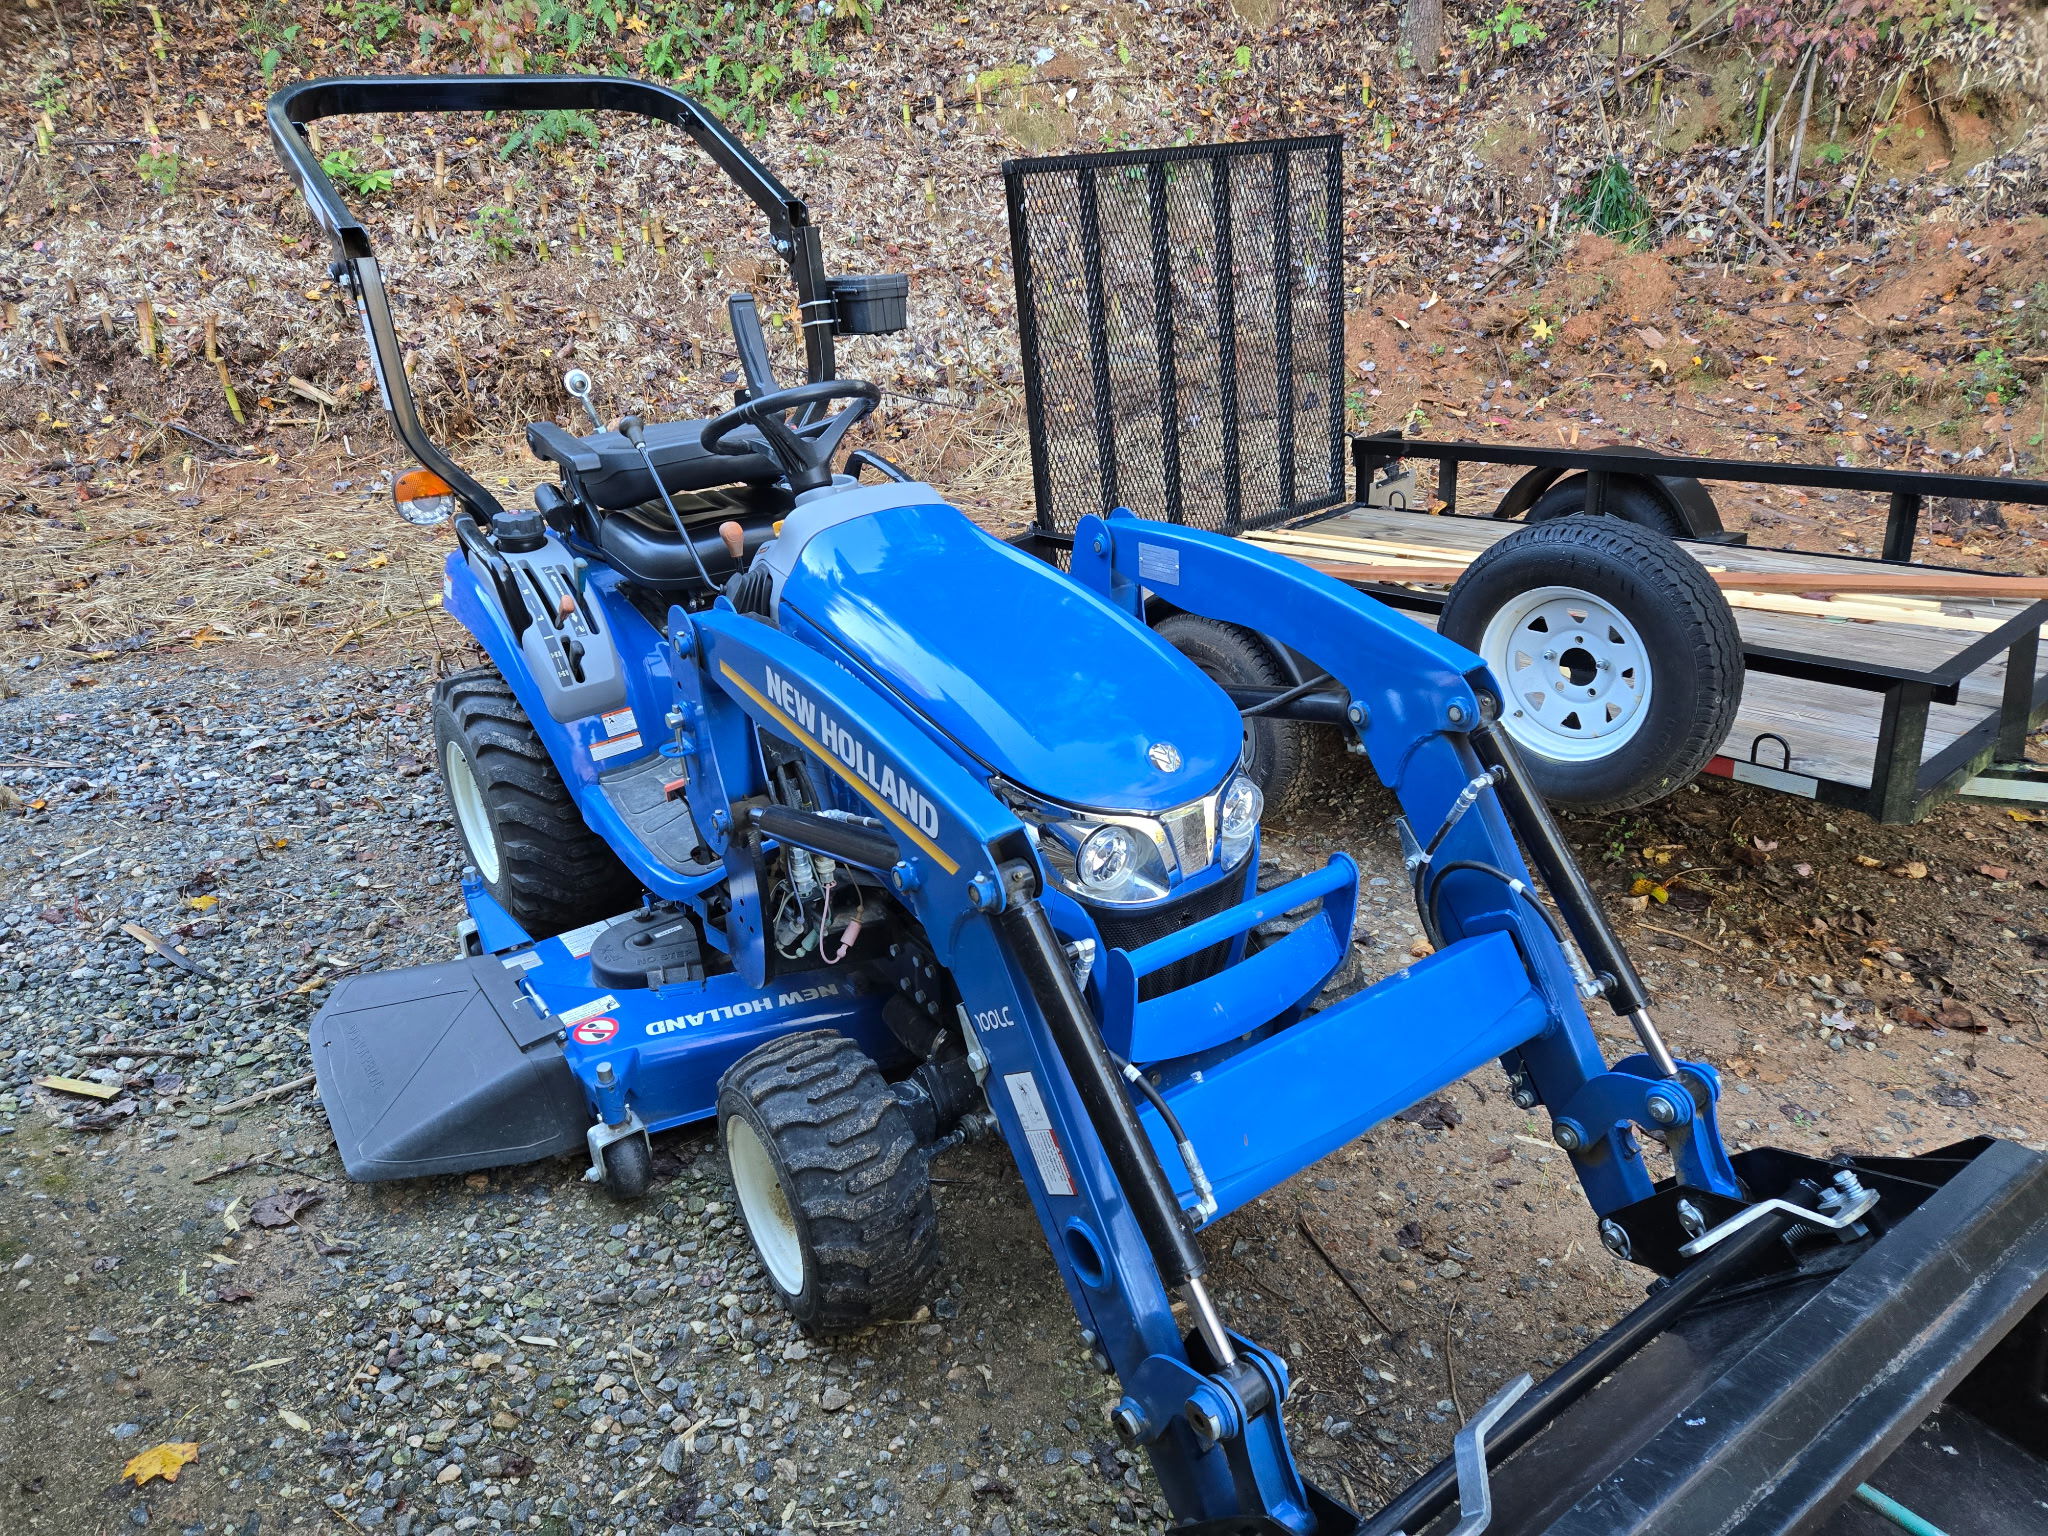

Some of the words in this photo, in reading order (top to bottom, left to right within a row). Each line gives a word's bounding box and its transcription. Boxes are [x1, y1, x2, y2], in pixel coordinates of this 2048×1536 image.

[765, 665, 816, 734] NEW
[820, 711, 939, 839] HOLLAND
[777, 983, 840, 1008] NEW
[645, 996, 774, 1036] HOLLAND
[973, 1006, 1015, 1033] 100LC
